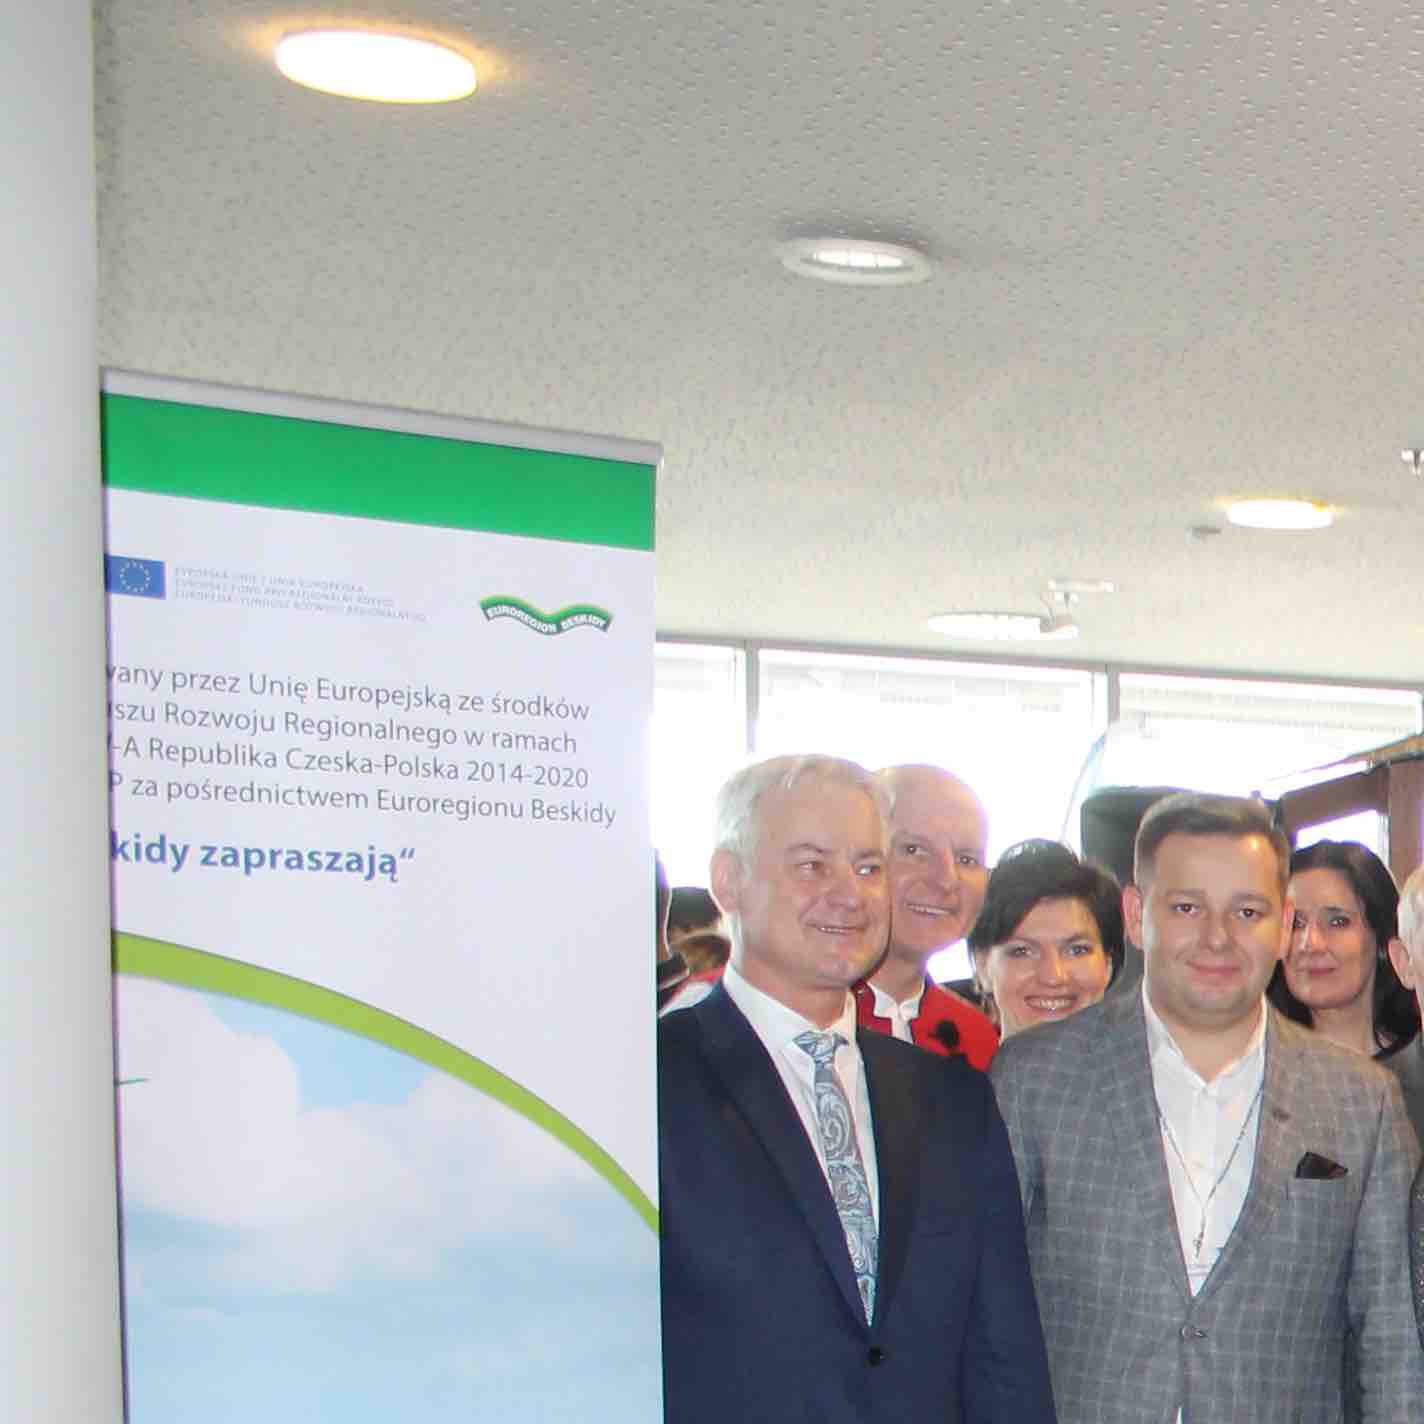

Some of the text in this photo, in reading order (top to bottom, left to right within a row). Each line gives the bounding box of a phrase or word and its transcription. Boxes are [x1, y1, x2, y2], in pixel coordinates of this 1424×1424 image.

[171, 671, 241, 695] przez
[249, 673, 309, 704] Unię
[316, 677, 452, 716] Europejską
[458, 694, 485, 713] ze
[491, 690, 590, 721] środków
[164, 702, 276, 737] Rozwoju
[284, 711, 458, 750] Regionalnego
[463, 729, 485, 747] w
[491, 731, 577, 753] ramach
[149, 737, 278, 769] Republika
[285, 747, 459, 781] Czeska-Polska
[466, 760, 590, 789] 2014-2020
[130, 778, 159, 798] za
[167, 778, 369, 809] pośrednictwem
[376, 788, 525, 821] Euroregionu
[530, 797, 617, 829] Beskidy
[111, 829, 190, 873] kidy
